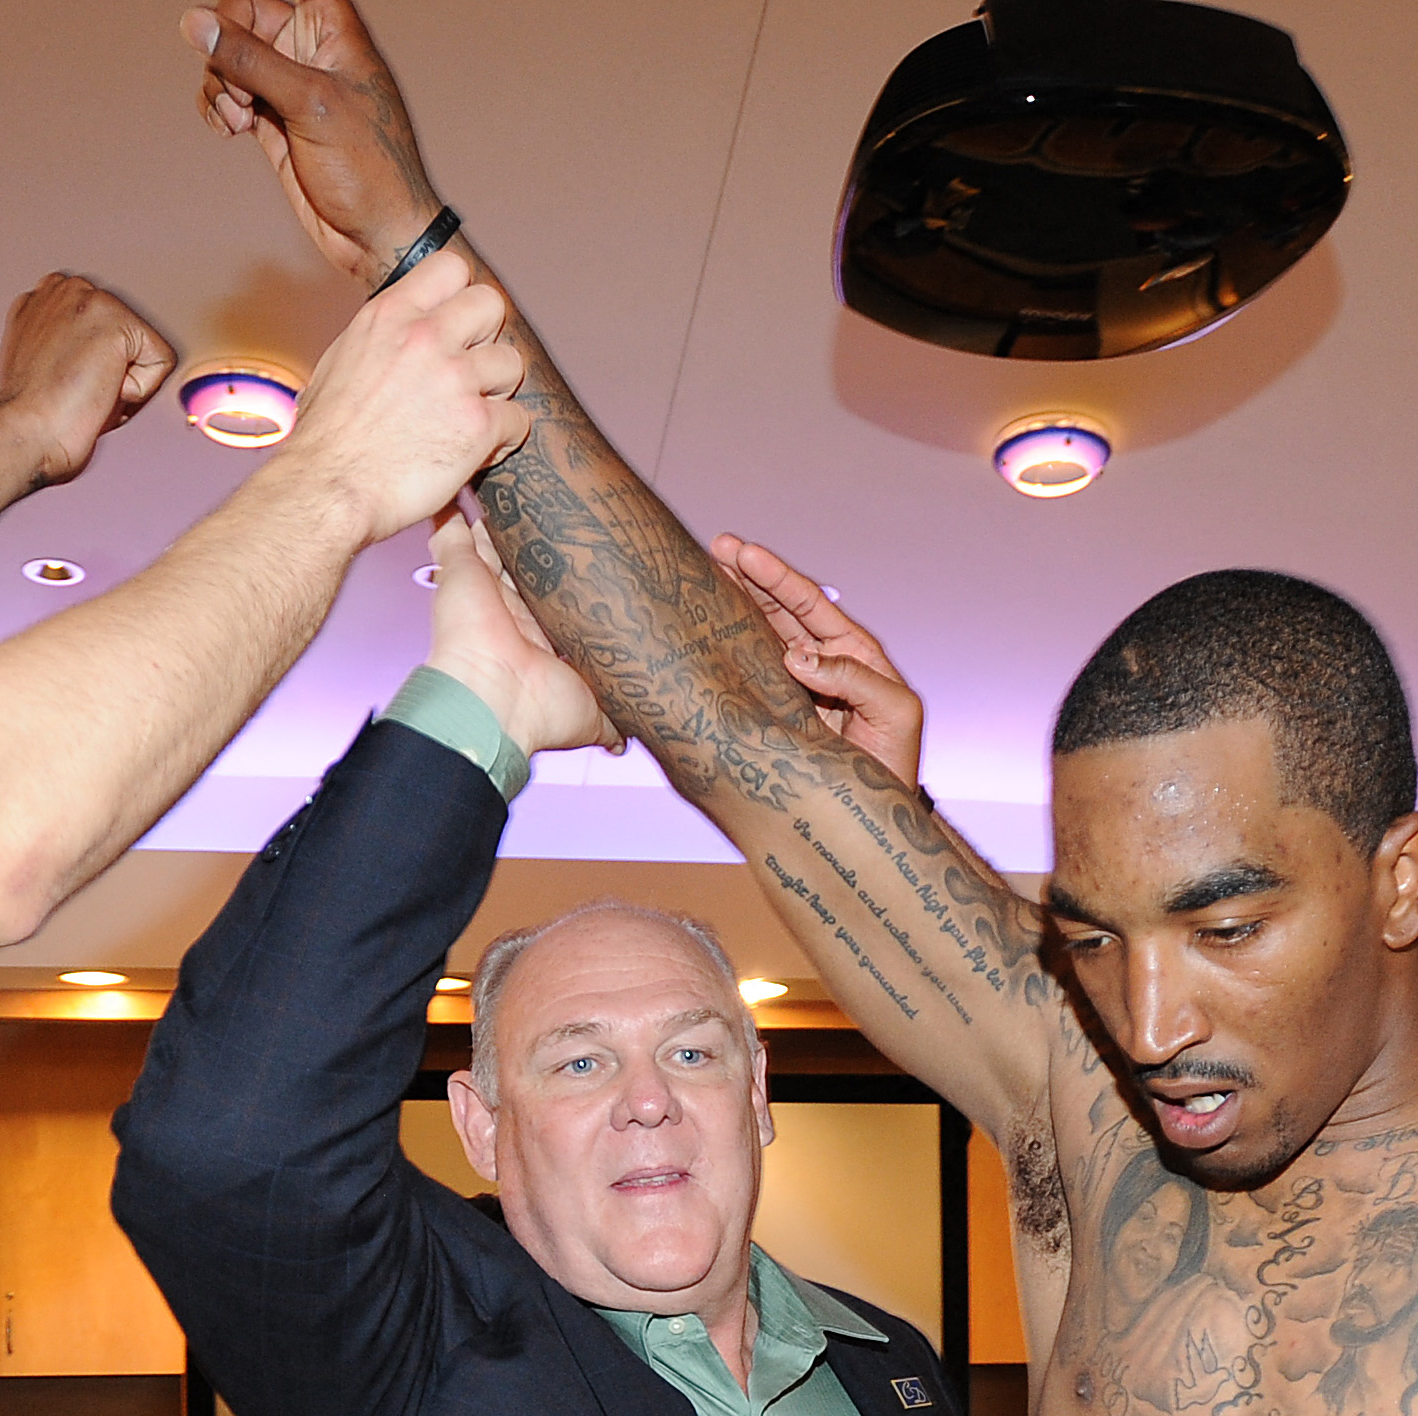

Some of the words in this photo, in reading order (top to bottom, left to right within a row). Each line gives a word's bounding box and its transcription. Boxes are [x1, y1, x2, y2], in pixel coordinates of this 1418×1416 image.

[764, 852, 810, 899] taught
[807, 893, 837, 925] keep
[835, 925, 861, 955] you
[859, 954, 919, 1020] grounded
[793, 817, 812, 842] the
[812, 840, 857, 890] morals
[857, 889, 888, 920] and
[883, 917, 923, 965] values
[921, 965, 947, 992] you
[947, 991, 973, 1026] were
[828, 782, 852, 806] No
[849, 803, 894, 854] matter
[892, 851, 918, 886] how
[916, 885, 949, 921] high
[940, 917, 969, 949] you
[963, 946, 988, 973] fly
[985, 967, 1007, 992] let
